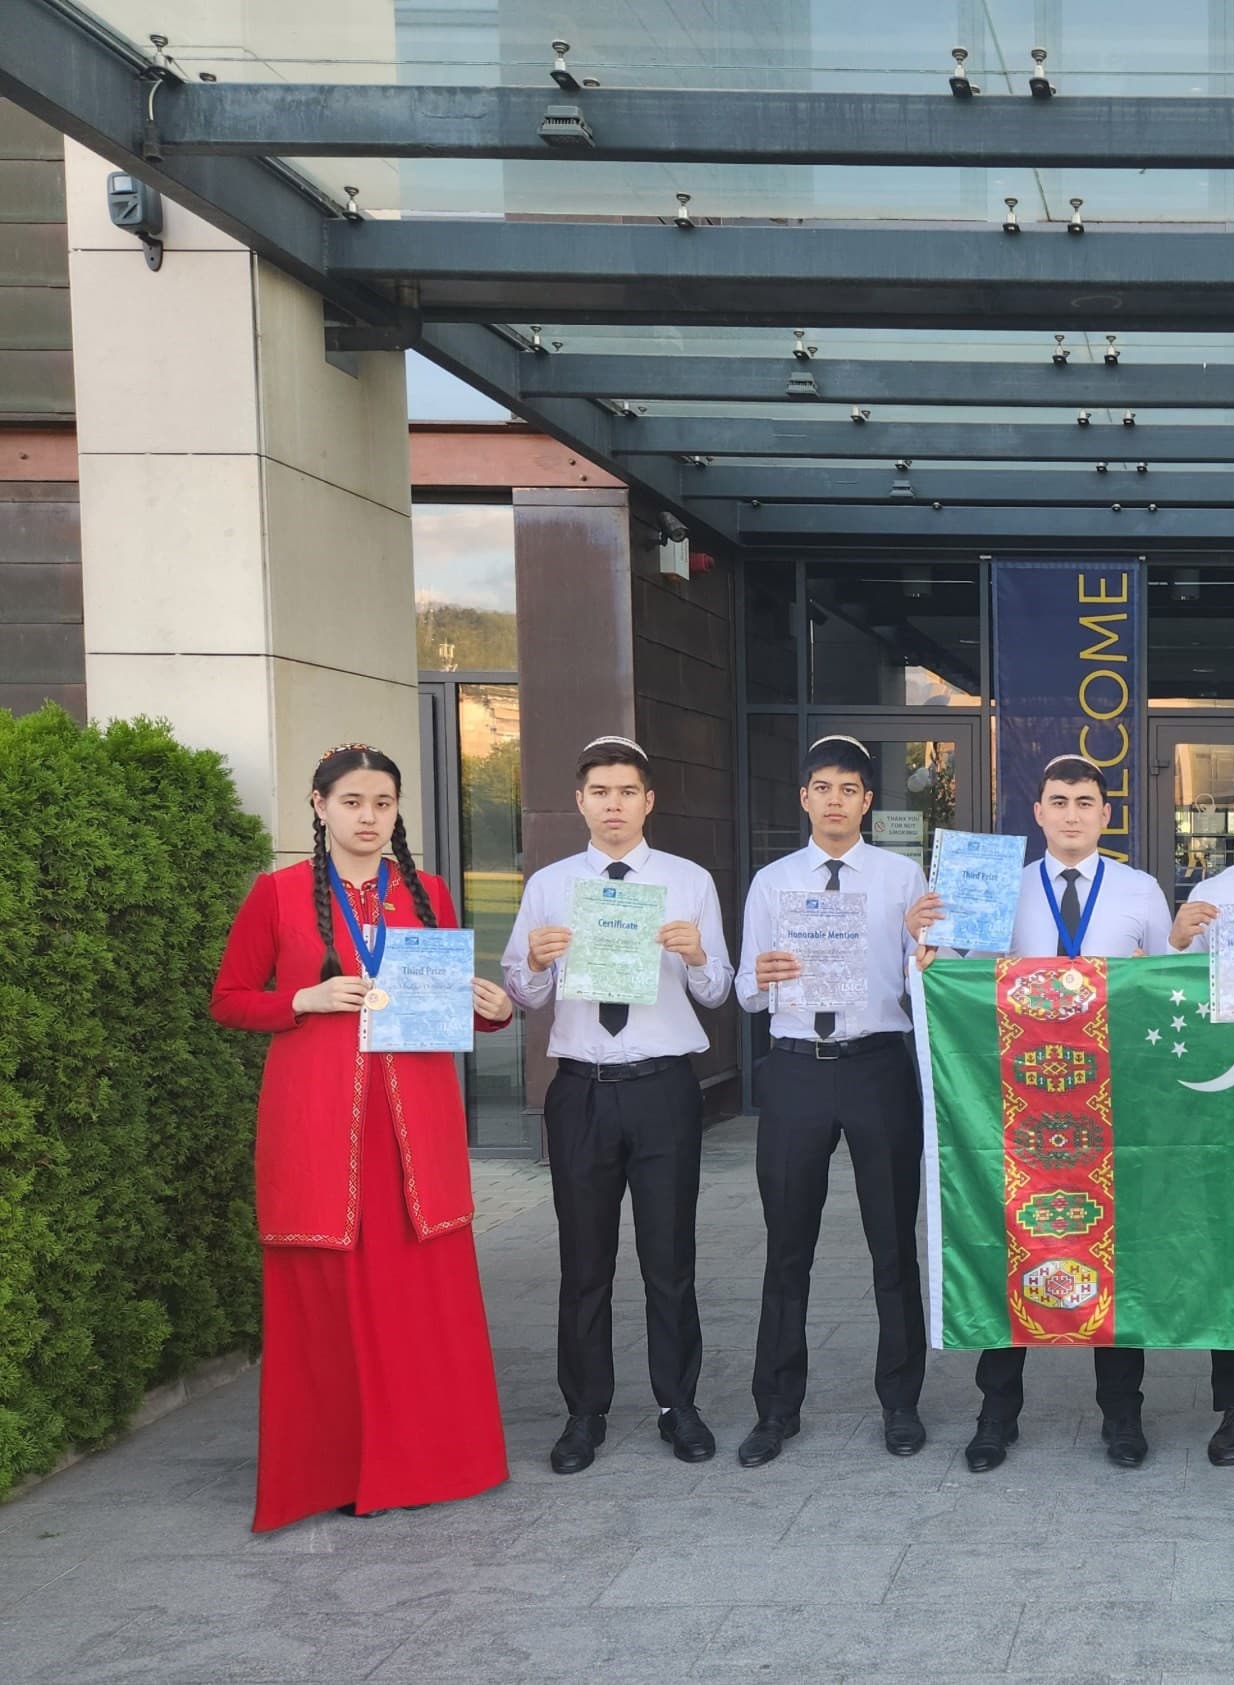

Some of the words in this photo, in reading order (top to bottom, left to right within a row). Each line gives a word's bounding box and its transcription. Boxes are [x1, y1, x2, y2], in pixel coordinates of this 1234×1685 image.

[1078, 573, 1129, 864] LCOME
[598, 918, 638, 930] Certificate
[787, 930, 826, 939] Honorable
[827, 930, 859, 939] Mention
